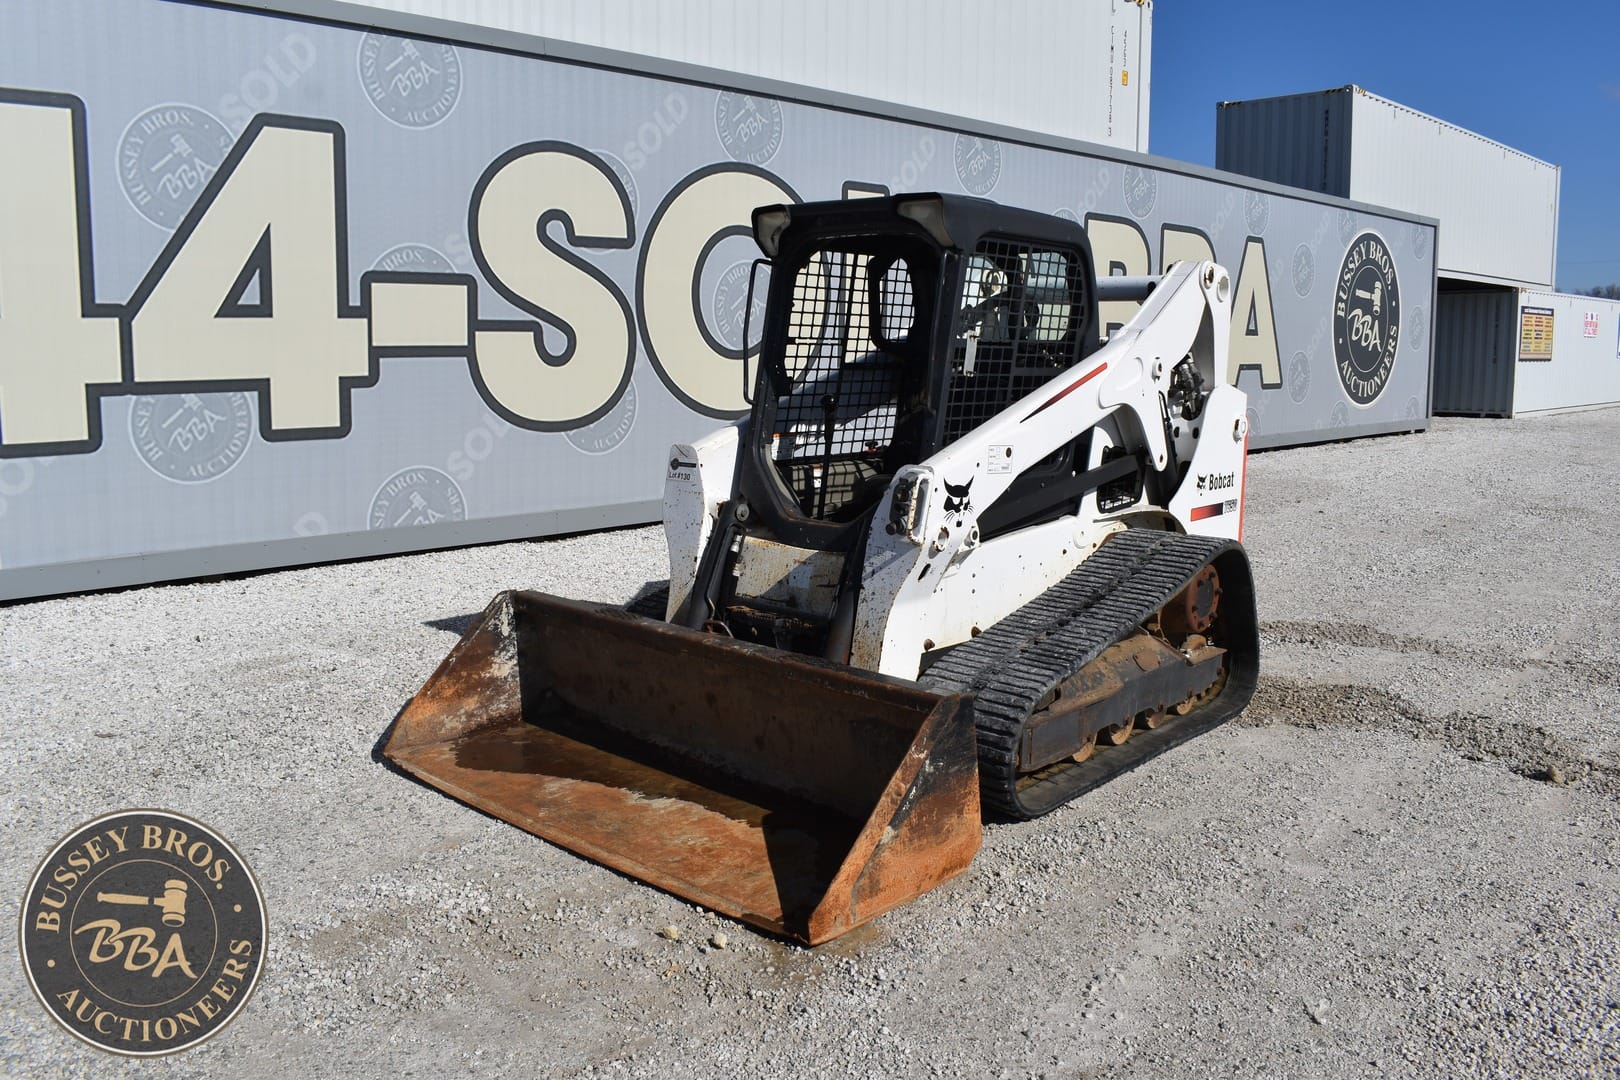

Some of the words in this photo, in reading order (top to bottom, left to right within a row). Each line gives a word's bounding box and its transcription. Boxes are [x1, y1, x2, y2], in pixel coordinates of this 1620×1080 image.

[387, 60, 441, 97] BBA
[735, 112, 770, 142] BBA
[1337, 241, 1368, 318] BUSSEY
[1369, 240, 1394, 291] BROS.
[1348, 308, 1381, 352] BBA
[1341, 325, 1397, 398] AUCTIONEERS
[168, 409, 227, 452] BBA
[1209, 471, 1234, 491] Bobcat
